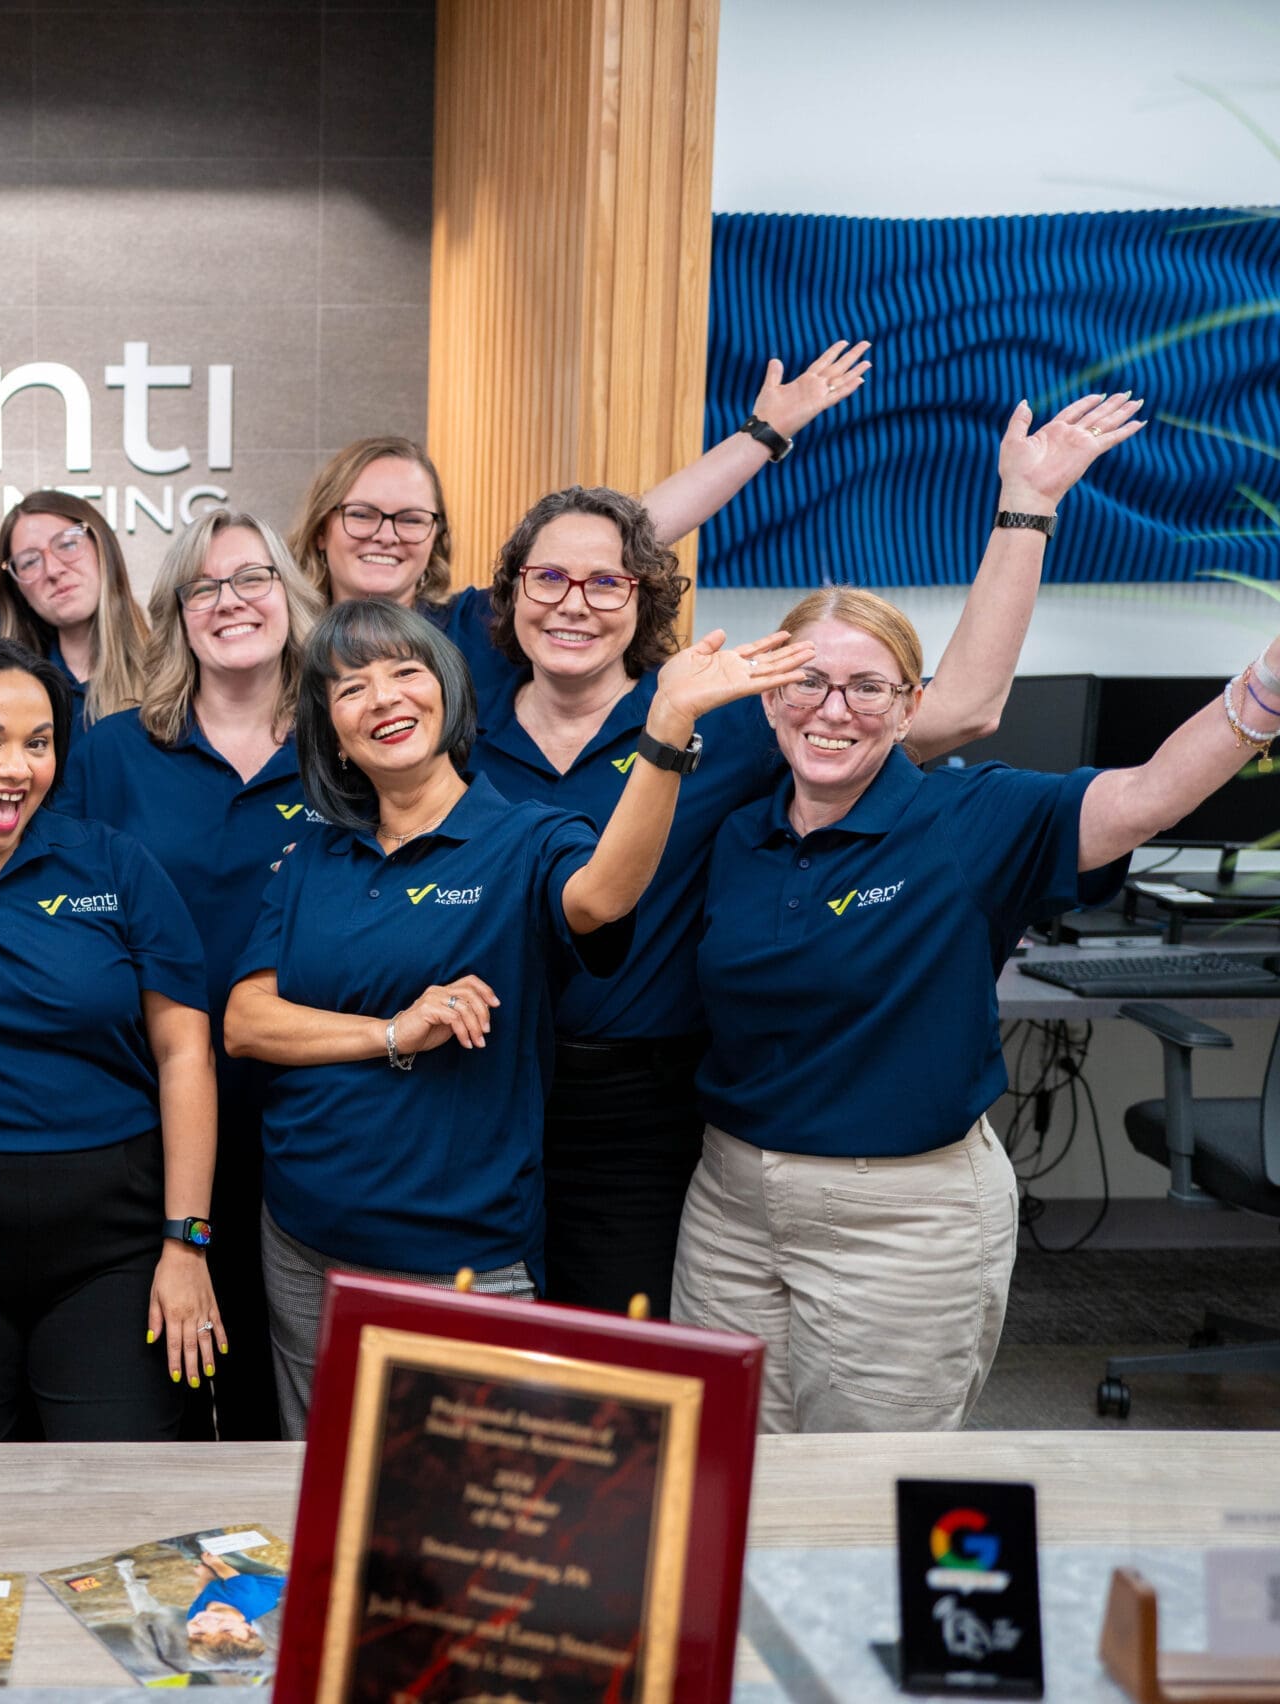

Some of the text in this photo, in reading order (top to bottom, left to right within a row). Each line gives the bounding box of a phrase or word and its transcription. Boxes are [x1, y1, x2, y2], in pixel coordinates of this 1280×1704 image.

[436, 885, 483, 900] vent
[68, 893, 118, 907] venti
[71, 904, 118, 912] ACCOUNTING
